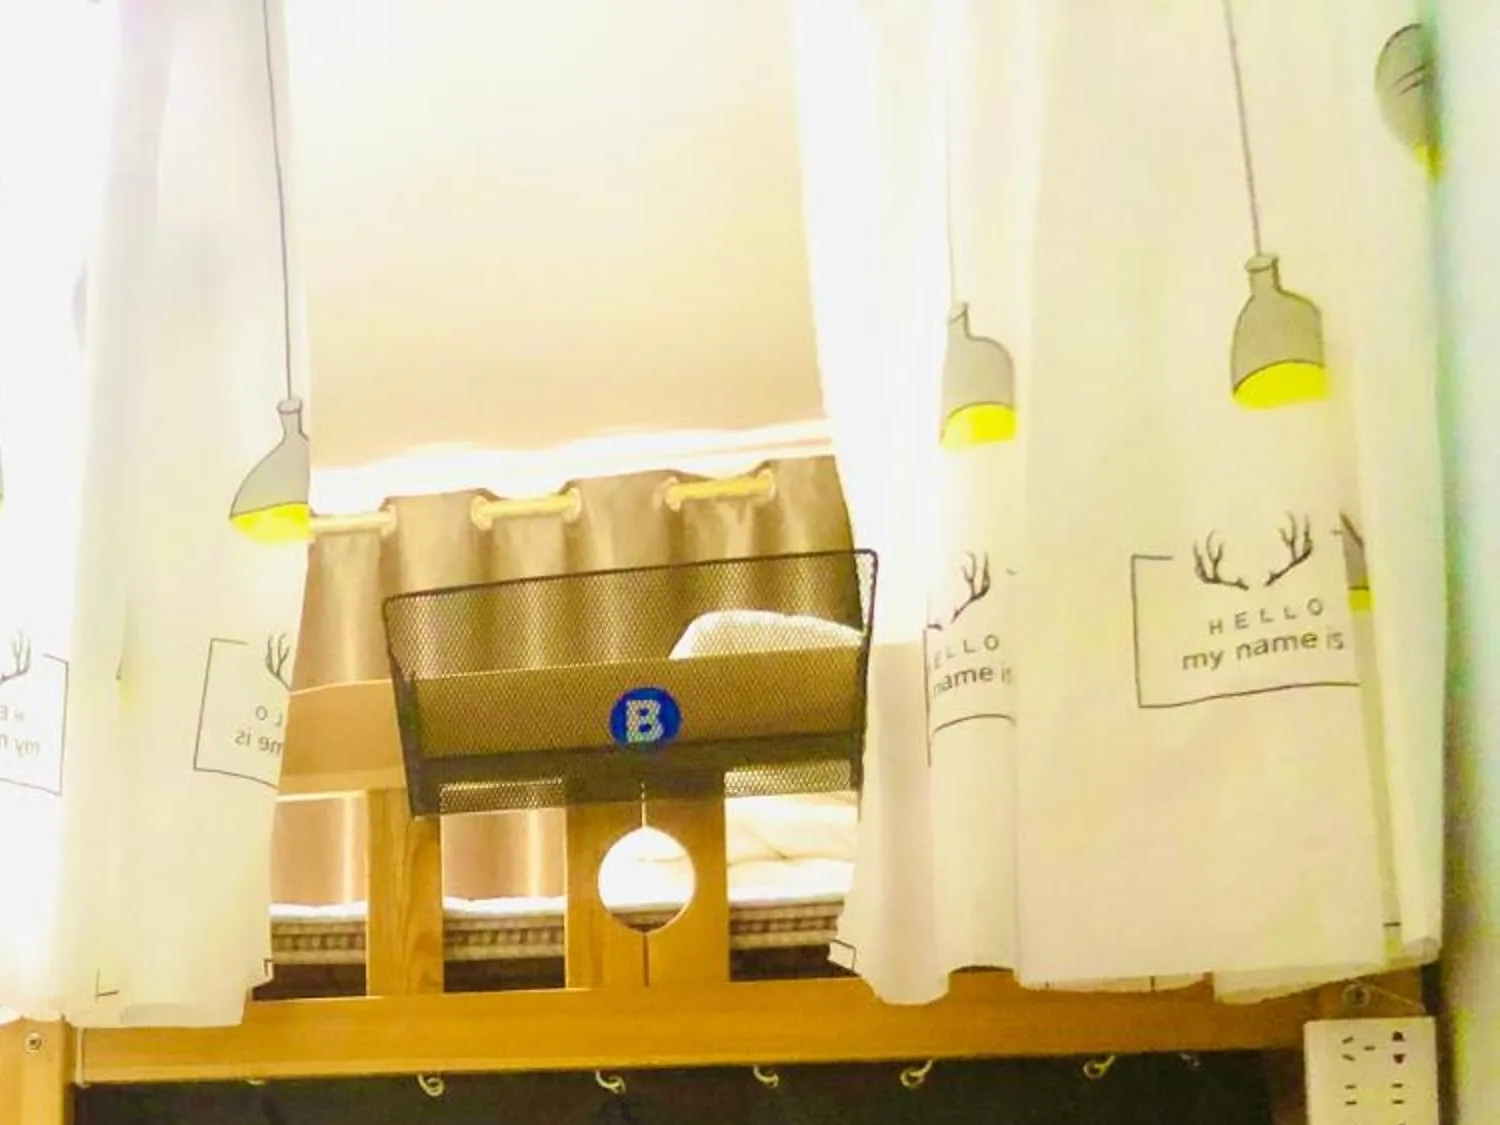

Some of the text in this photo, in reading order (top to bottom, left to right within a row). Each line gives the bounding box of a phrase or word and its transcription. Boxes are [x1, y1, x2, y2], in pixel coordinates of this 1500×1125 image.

[1208, 598, 1324, 635] HELLO
[933, 634, 1000, 671] ELLO
[1182, 627, 1344, 671] my name is
[626, 700, 664, 742] B
